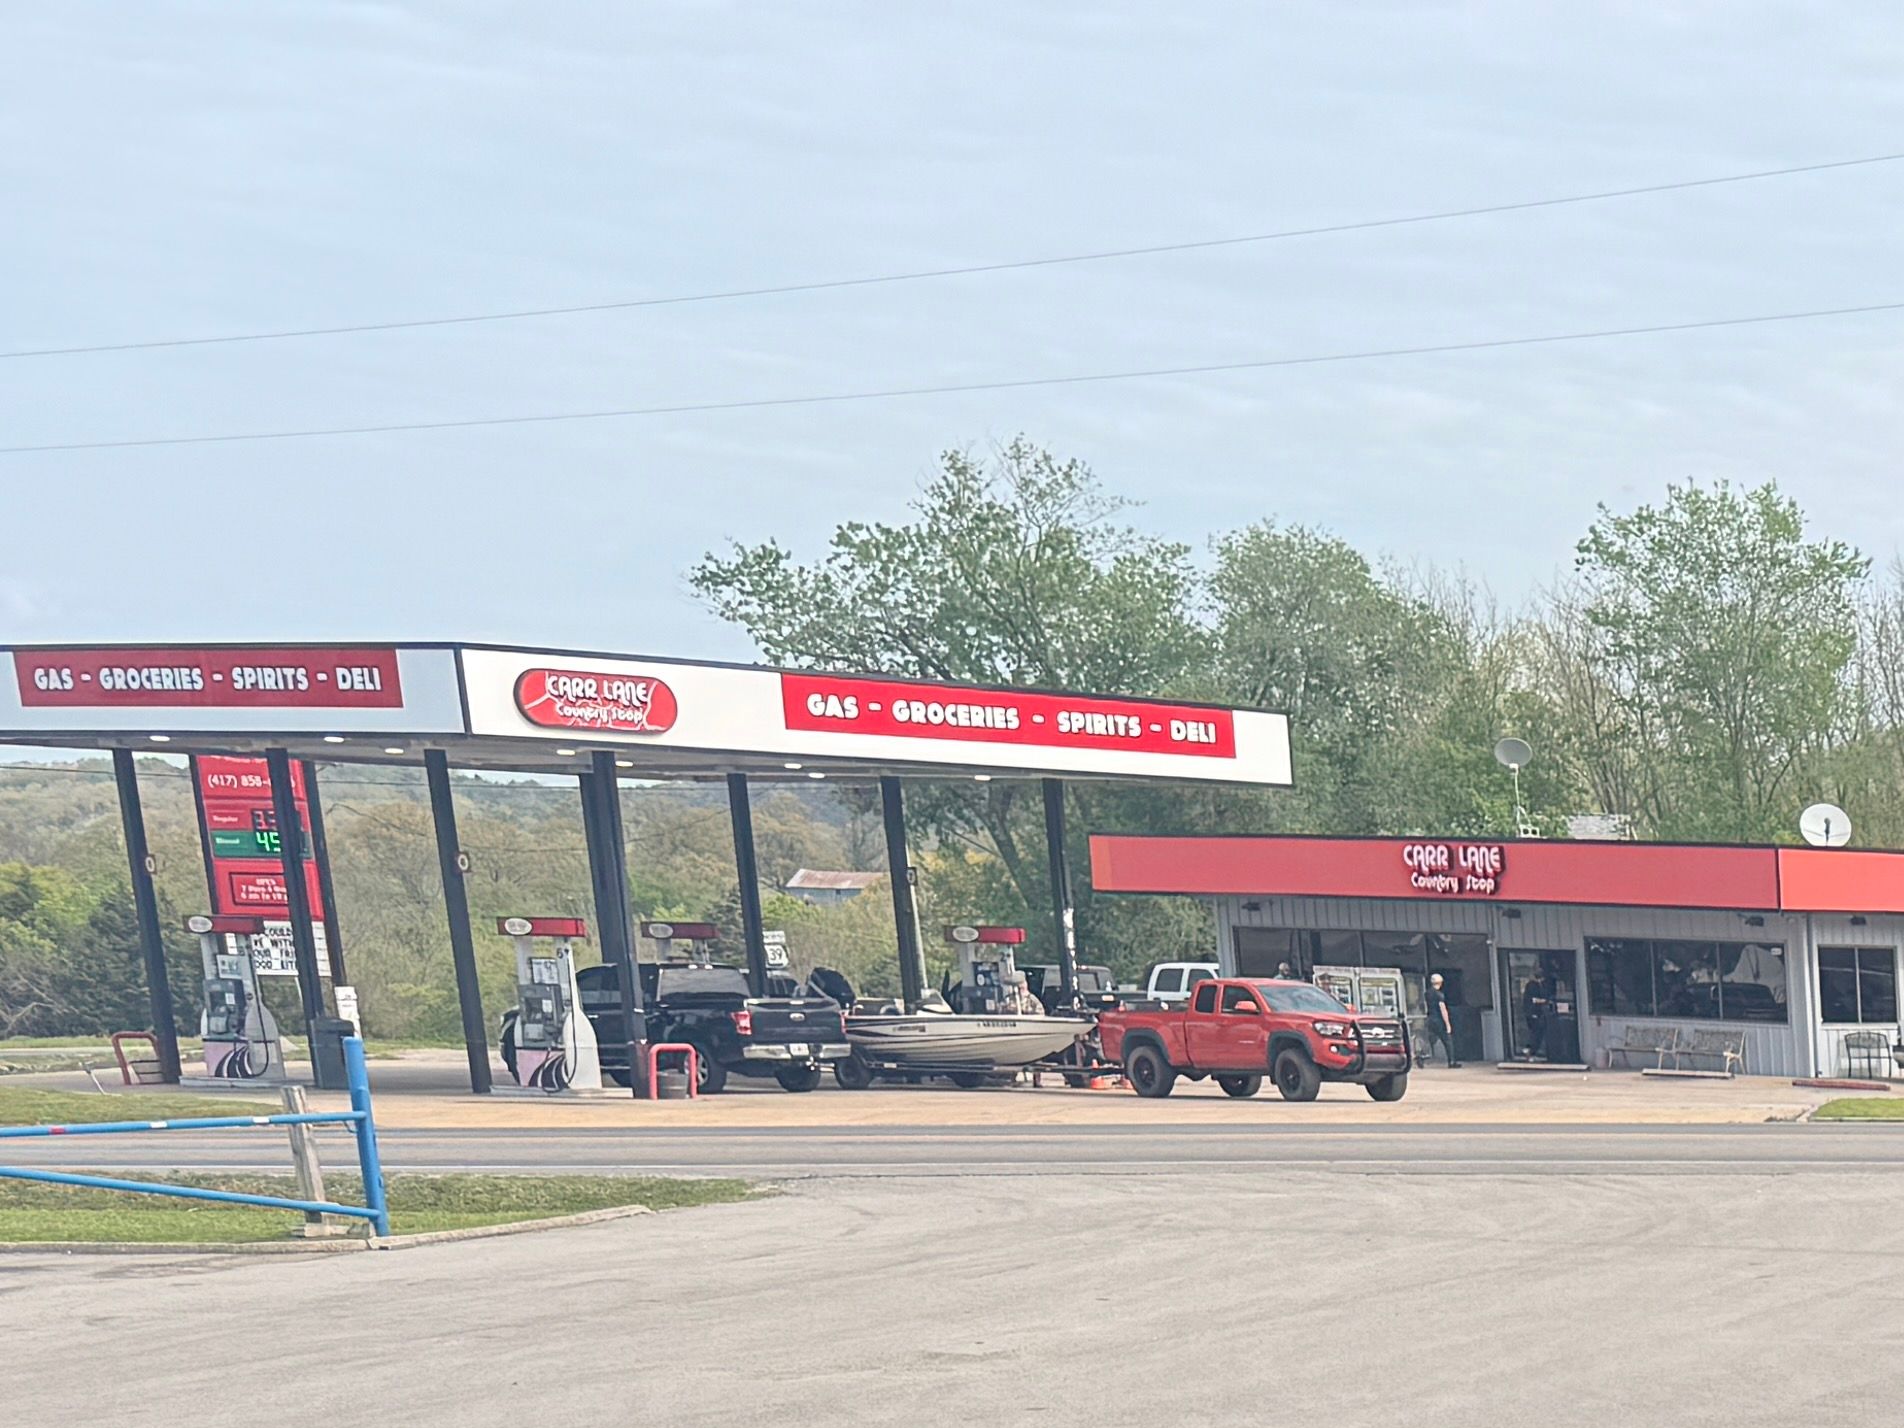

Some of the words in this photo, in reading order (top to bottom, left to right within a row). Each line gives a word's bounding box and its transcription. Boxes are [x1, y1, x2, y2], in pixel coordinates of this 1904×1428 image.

[34, 668, 73, 691] GAS
[100, 667, 204, 691] GROCERIES
[232, 667, 308, 691] SPIRITS
[336, 667, 382, 691] DELI
[548, 675, 598, 702] CARR
[603, 679, 649, 707] LANE
[555, 702, 609, 723] Country
[611, 707, 644, 724] Stop
[807, 693, 859, 719] GAS
[892, 699, 1020, 730] GROCERIES
[1056, 710, 1141, 737] SPIRITS
[1170, 718, 1217, 744] DELI
[1403, 844, 1449, 875] CARR
[1459, 845, 1501, 876] LANE
[1411, 872, 1459, 893] Country
[1465, 874, 1496, 895] Stop
